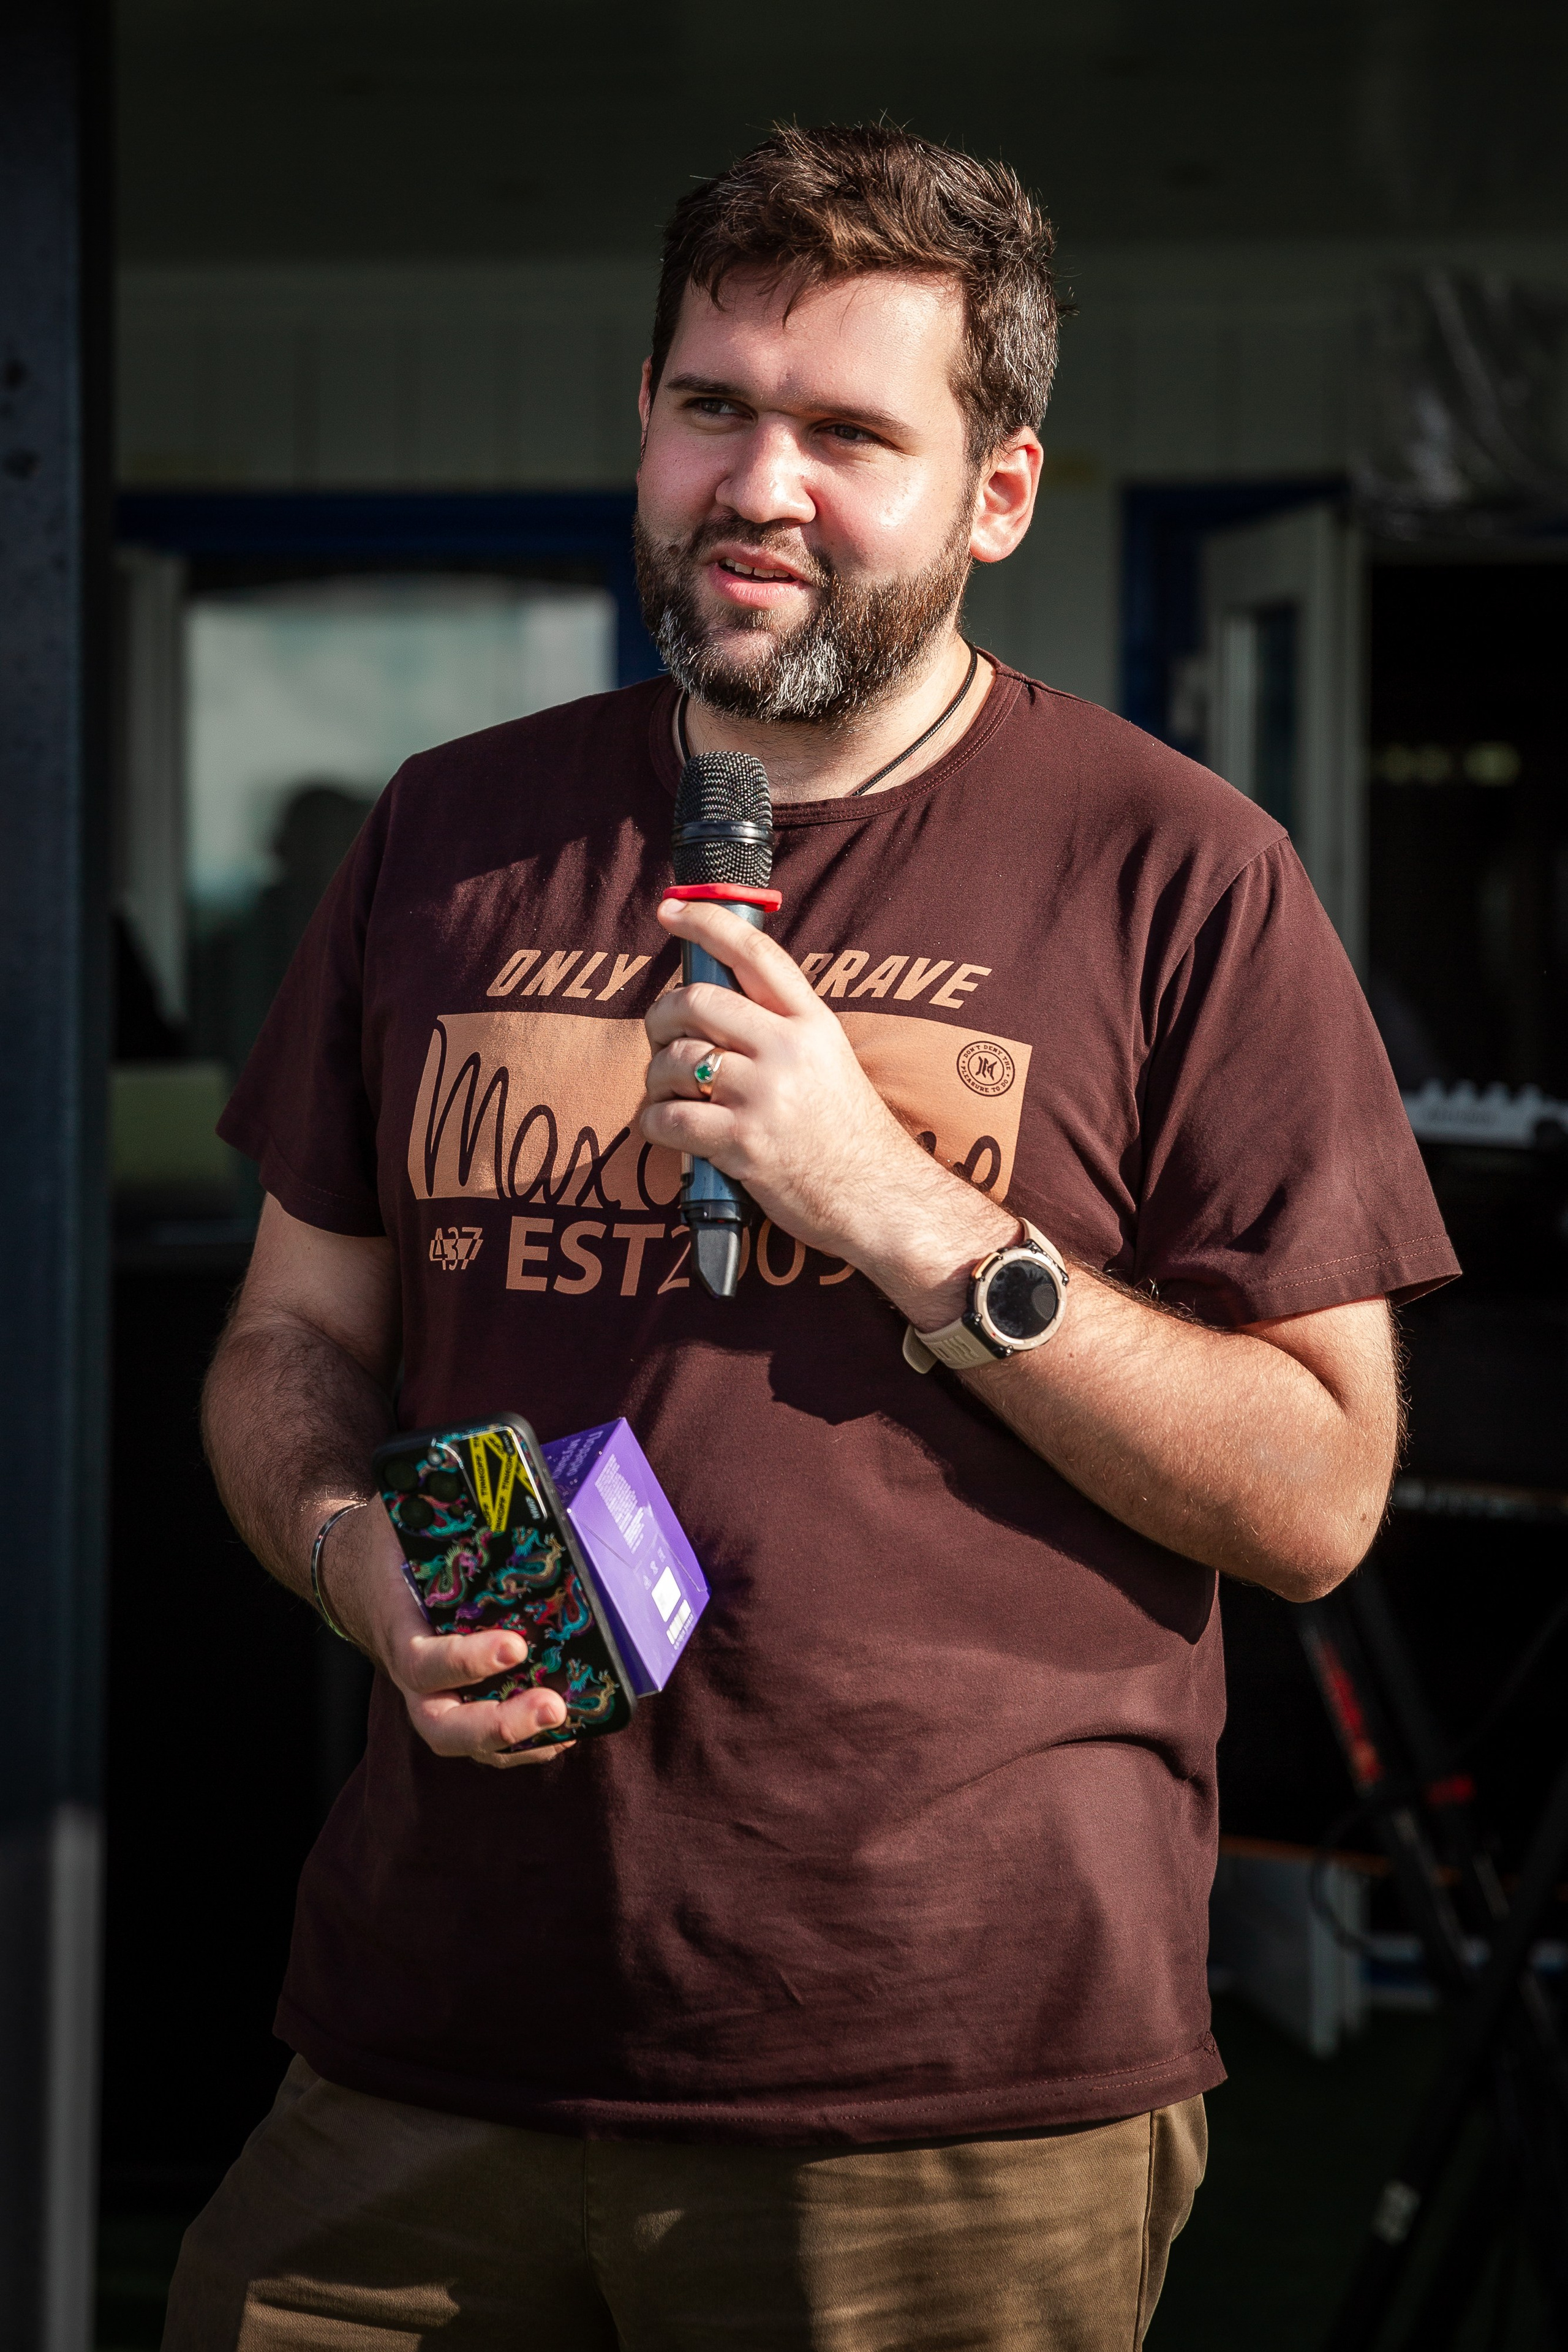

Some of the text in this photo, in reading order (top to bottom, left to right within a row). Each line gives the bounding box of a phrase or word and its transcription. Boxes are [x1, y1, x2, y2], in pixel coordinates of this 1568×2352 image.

[487, 949, 652, 1001] ONLY
[963, 1045, 1011, 1071] DON'T DENY THE
[960, 1066, 990, 1093] PLEASURE
[1000, 1079, 1009, 1088] DO
[429, 1227, 484, 1271] 437
